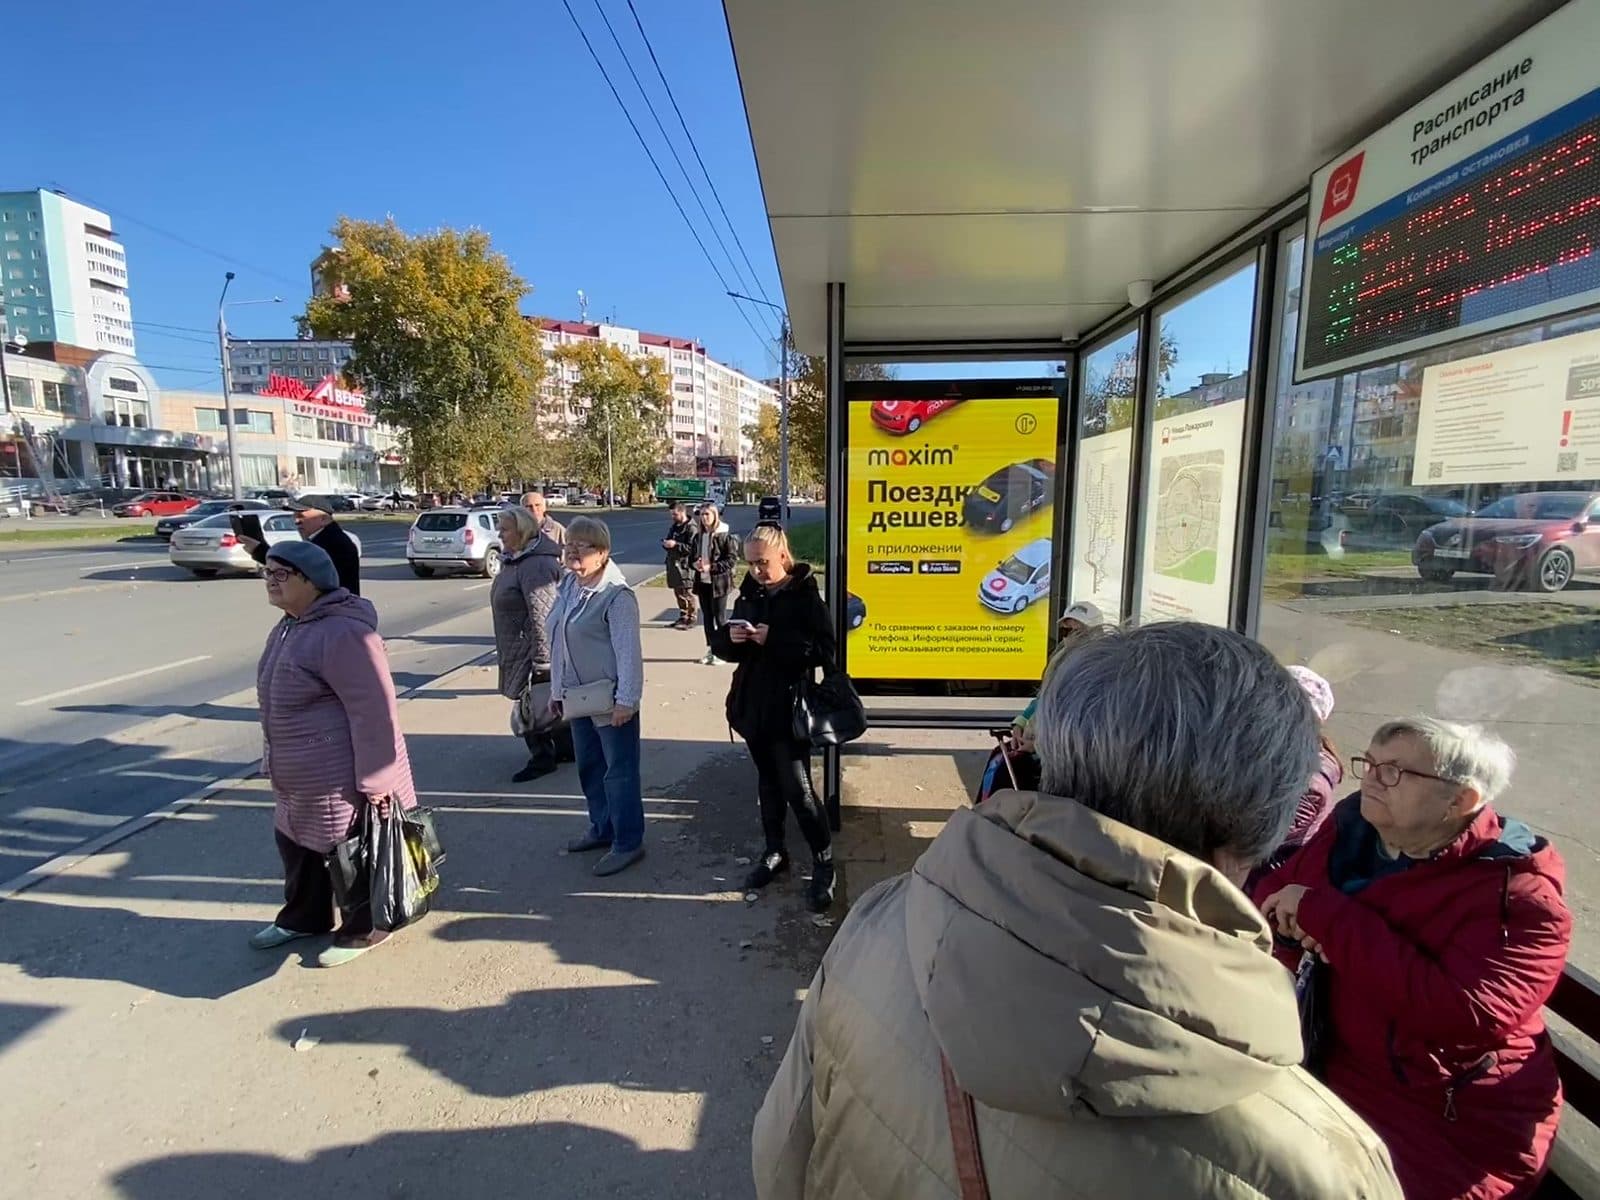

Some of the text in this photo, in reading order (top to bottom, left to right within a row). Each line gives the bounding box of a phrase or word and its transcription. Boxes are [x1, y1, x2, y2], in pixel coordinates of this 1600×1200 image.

[1412, 57, 1533, 142] Расписание
[1410, 87, 1525, 166] транспорта
[1406, 171, 1459, 205] Конечная
[1461, 134, 1530, 177] остановка
[868, 444, 953, 466] maxim
[868, 480, 978, 507] Поездк
[867, 544, 963, 557] в приложении
[874, 623, 887, 631] По
[888, 624, 936, 633] сравнению
[944, 624, 979, 632] заказом
[980, 624, 992, 632] по
[993, 624, 1025, 633] номеру
[912, 633, 993, 644] Информационный
[868, 644, 897, 653] Услуги
[898, 645, 954, 654] оказываются
